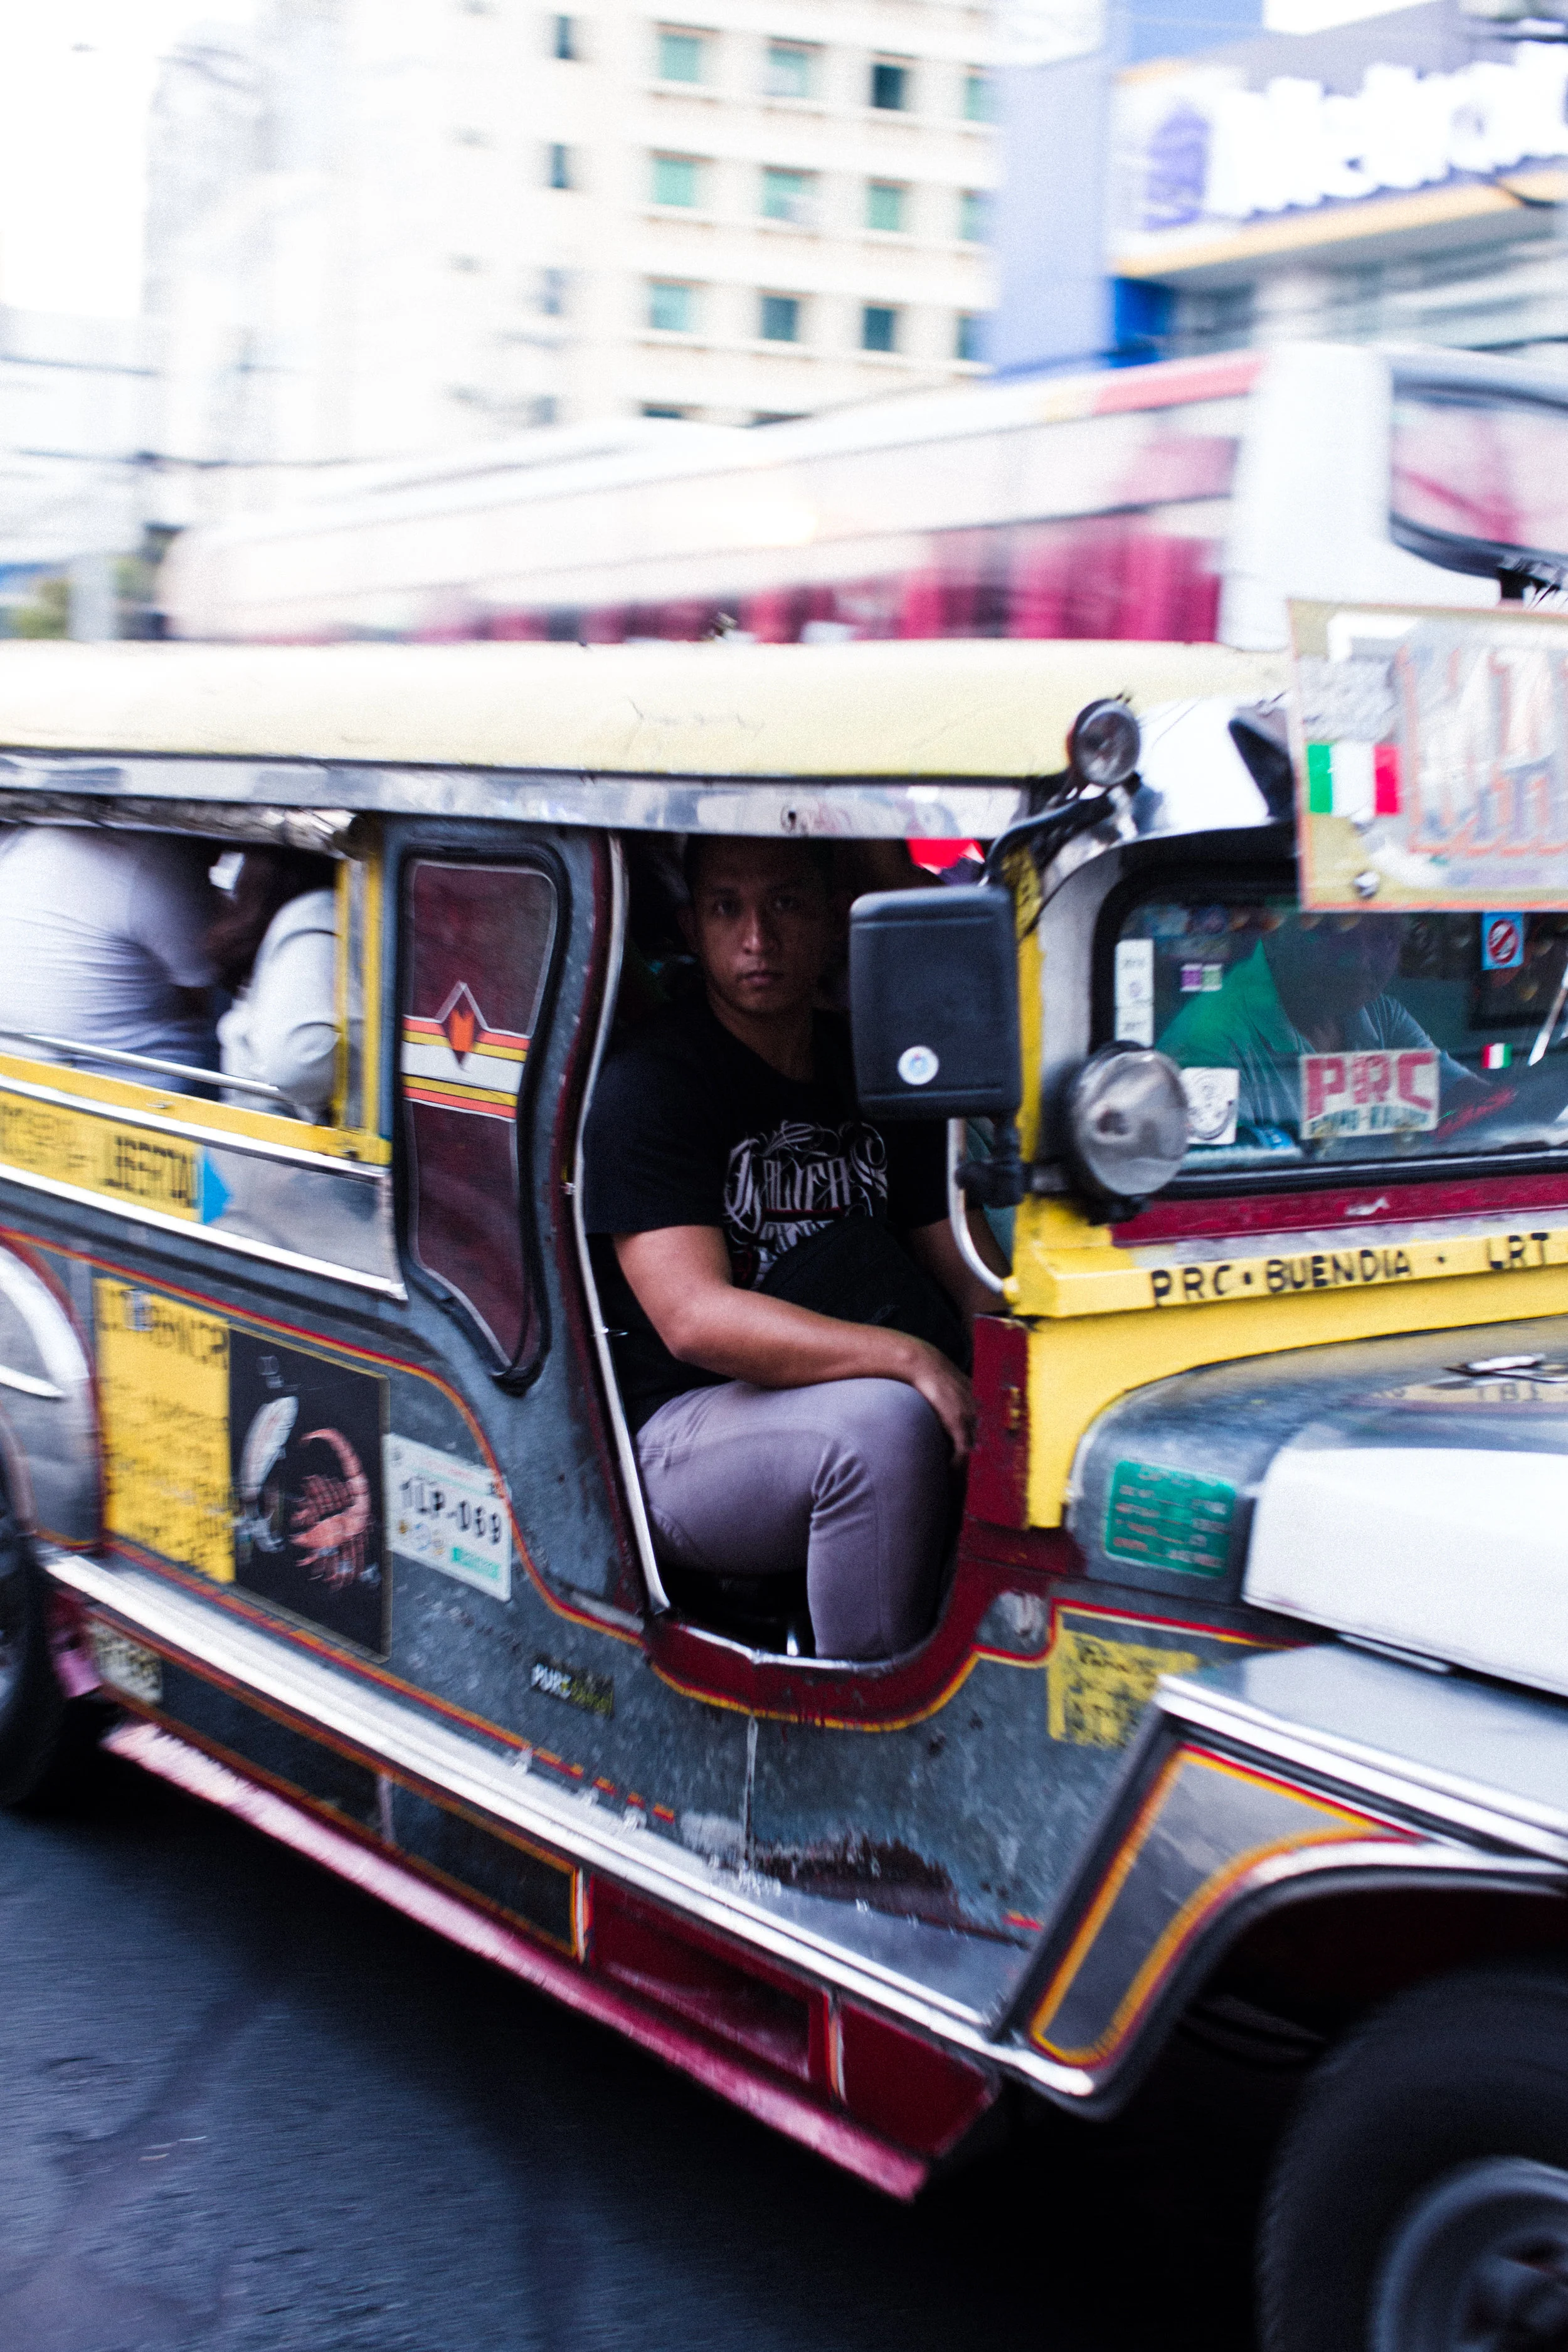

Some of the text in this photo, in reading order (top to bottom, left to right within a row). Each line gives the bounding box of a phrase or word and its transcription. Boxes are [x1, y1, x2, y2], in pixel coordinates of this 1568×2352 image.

[1306, 1051, 1435, 1121] PRC
[1151, 1232, 1549, 1306] PRC BUENDIA LRT
